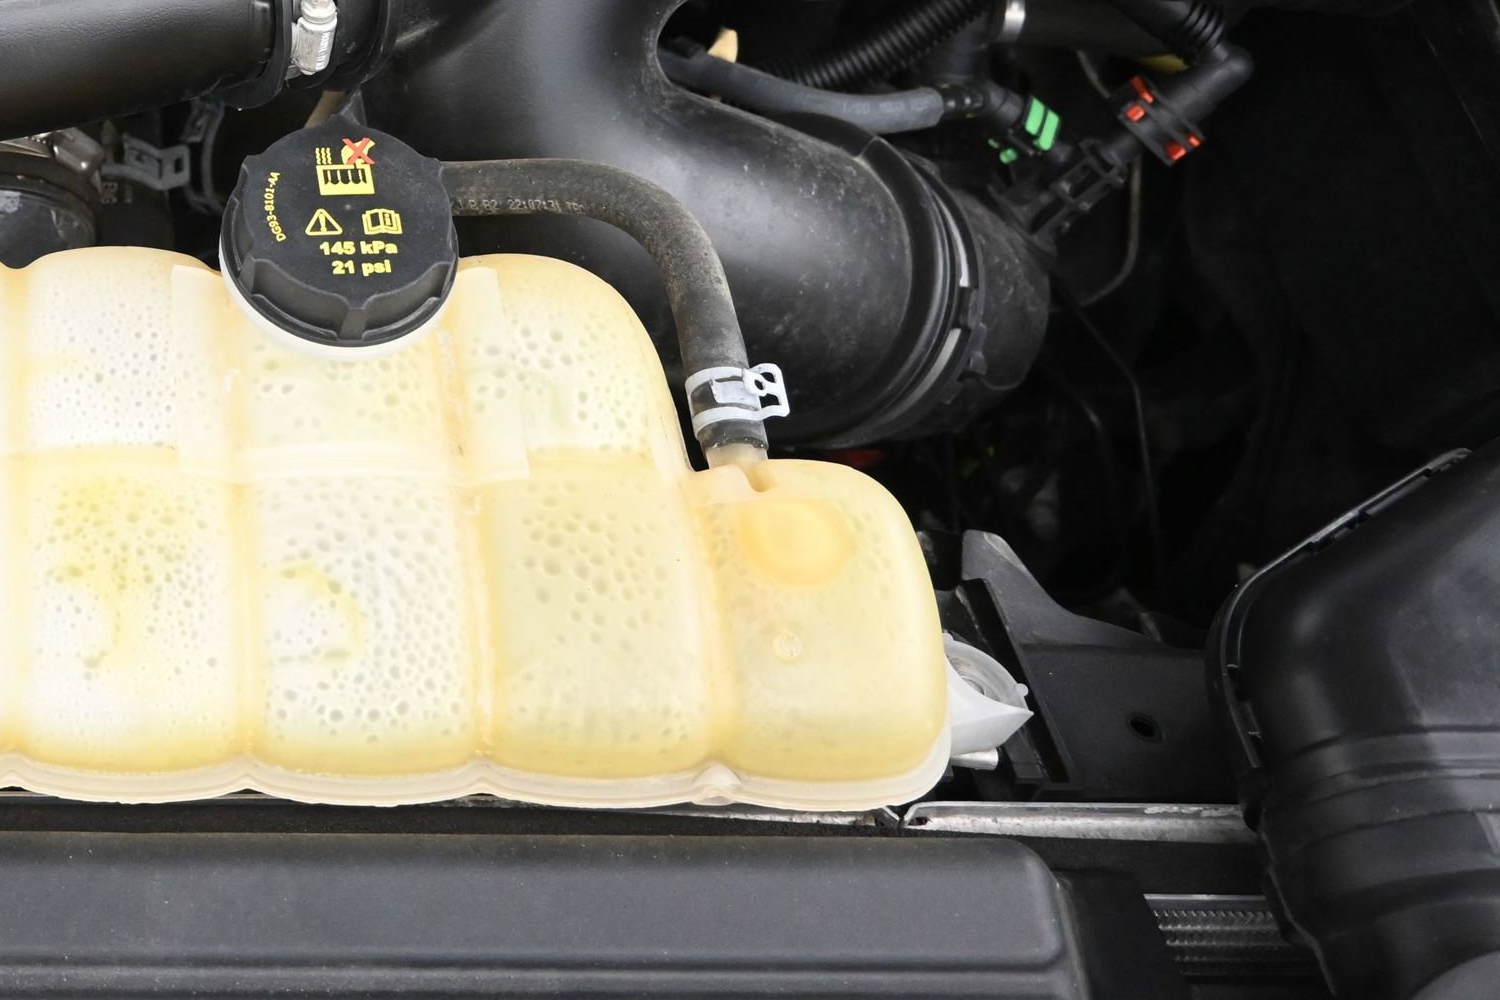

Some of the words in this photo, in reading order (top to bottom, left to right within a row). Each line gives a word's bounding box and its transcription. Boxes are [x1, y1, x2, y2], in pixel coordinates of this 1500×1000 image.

[264, 171, 287, 242] DG93-8101-AA
[319, 241, 356, 256] 145
[360, 240, 398, 255] kPa
[332, 261, 356, 275] 21
[362, 259, 392, 276] psi
